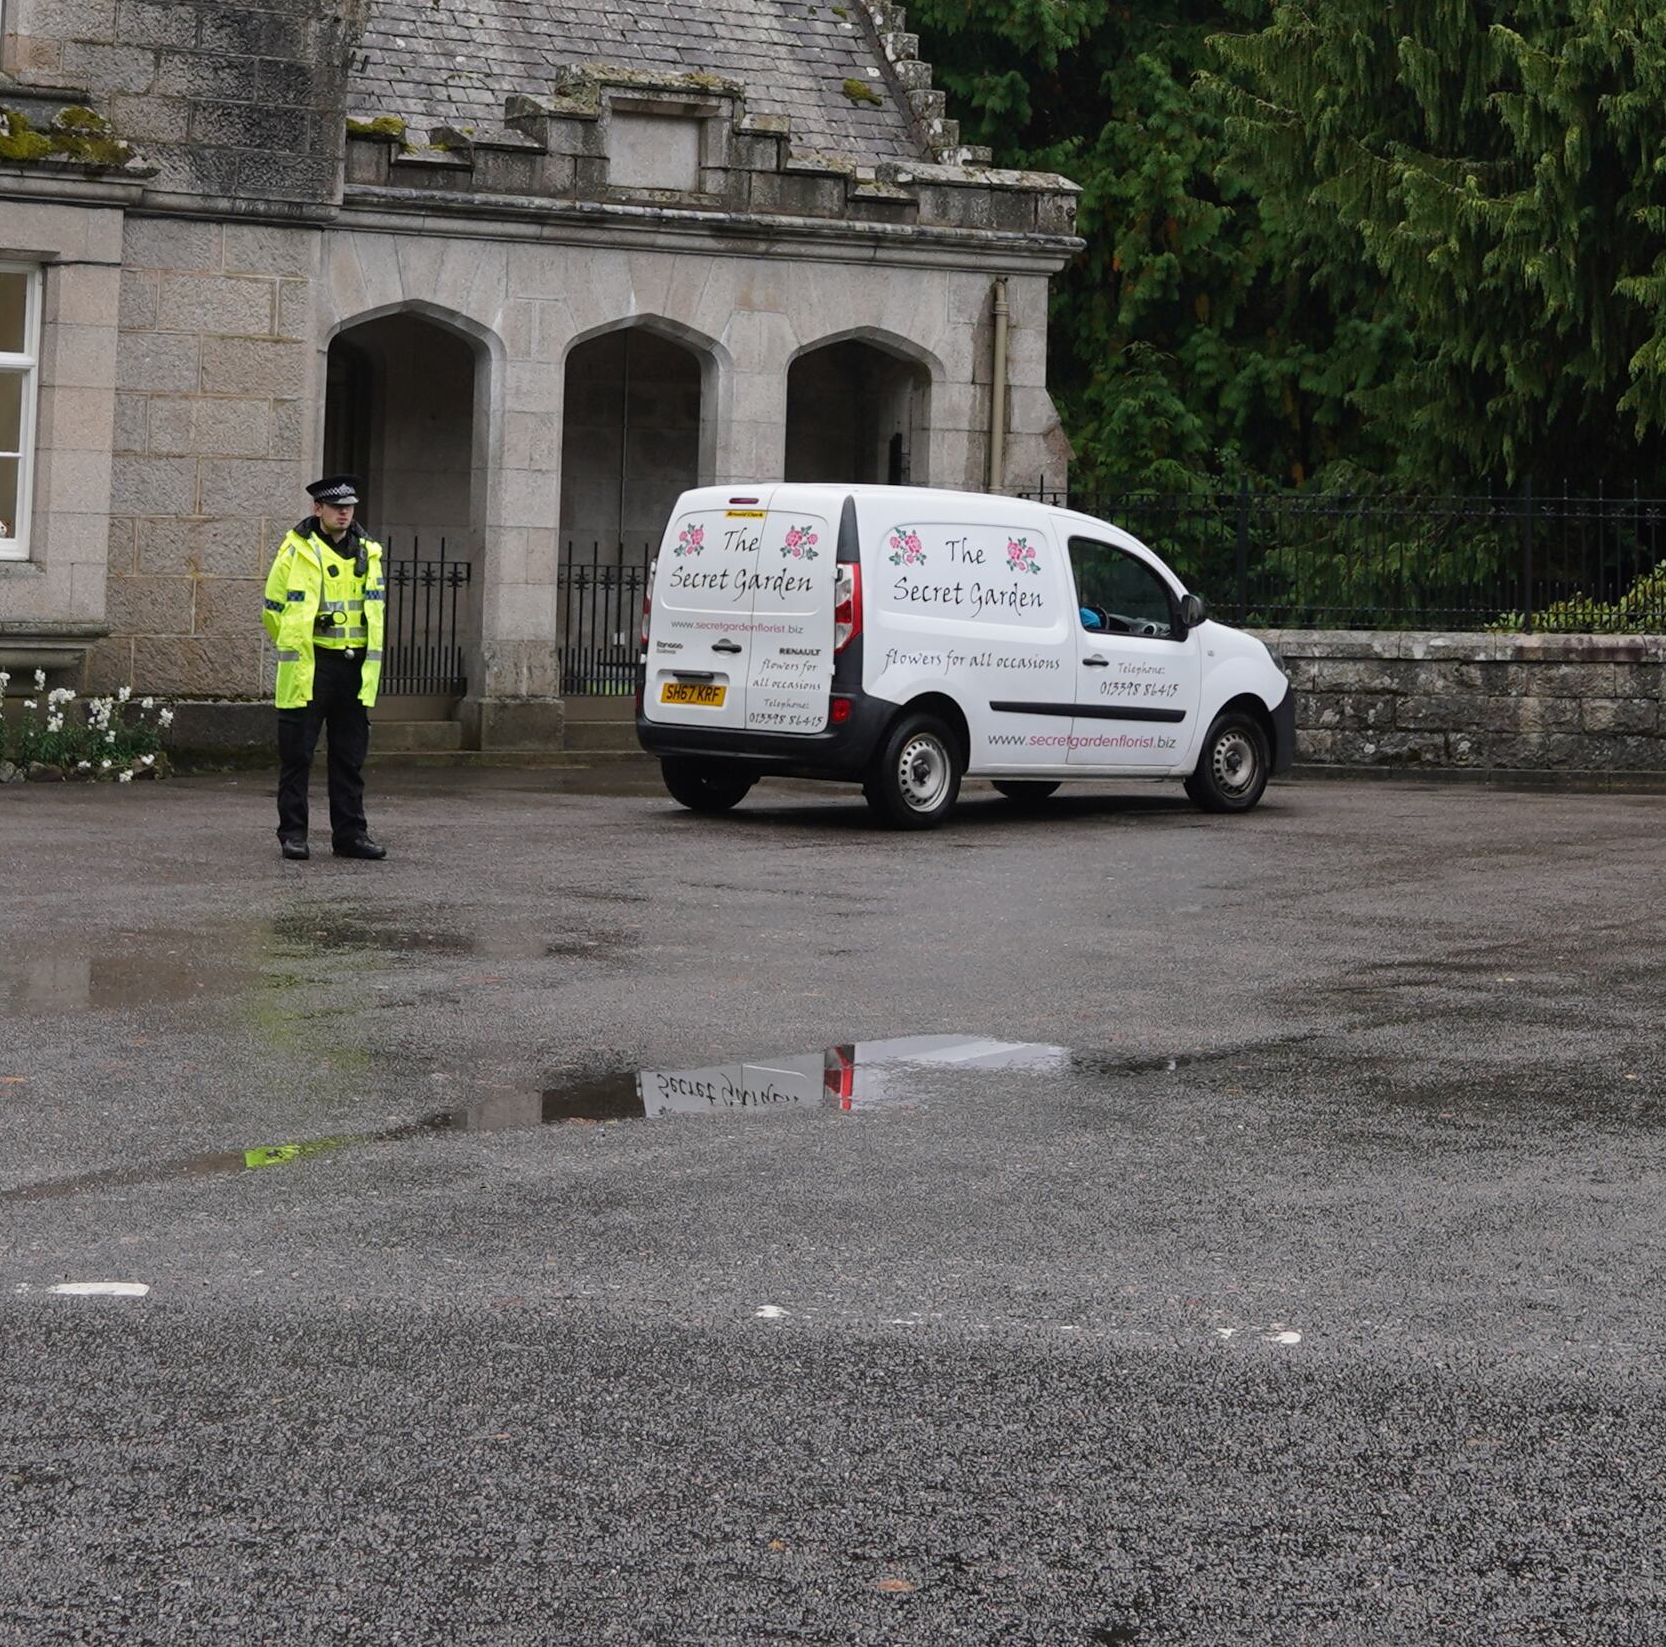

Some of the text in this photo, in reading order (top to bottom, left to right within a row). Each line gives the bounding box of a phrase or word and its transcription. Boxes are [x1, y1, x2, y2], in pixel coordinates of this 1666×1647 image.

[724, 527, 760, 552] The
[945, 537, 986, 564] The
[669, 565, 813, 602] Secret Garden
[893, 576, 1044, 618] Secret Garden
[671, 620, 804, 634] www.secretgardenflorist.biz
[779, 648, 822, 656] RENAULT
[761, 658, 819, 677] flowers for
[883, 648, 1061, 676] flowers for all occasions
[1118, 661, 1166, 678] Telephone:
[666, 684, 722, 702] SH67 KRF
[752, 678, 822, 692] all occasions
[1100, 681, 1180, 698] 013398 86415
[988, 733, 1177, 750] www.secretgardenflorist.biz
